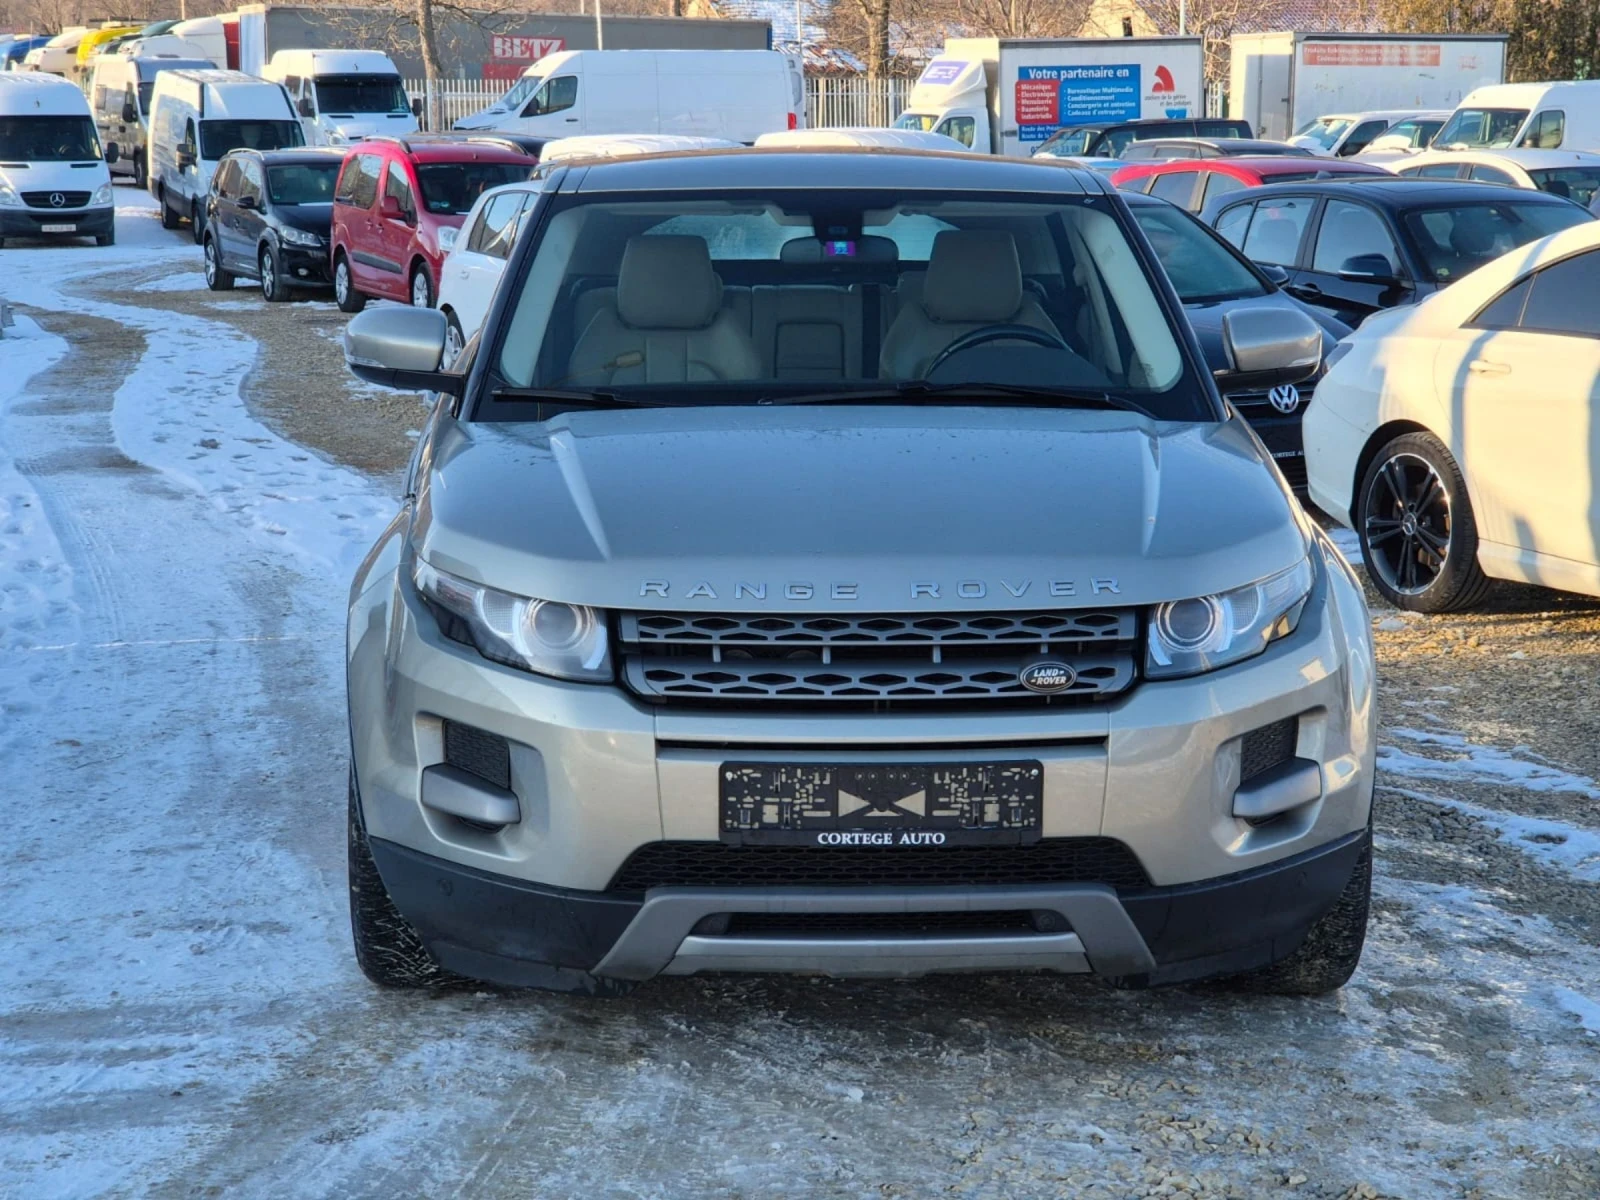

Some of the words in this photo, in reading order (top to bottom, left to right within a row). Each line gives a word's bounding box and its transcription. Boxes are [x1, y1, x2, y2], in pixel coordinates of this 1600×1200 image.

[493, 36, 562, 58] BETZ
[1028, 68, 1058, 79] Votre
[1060, 66, 1114, 81] partenaire
[1116, 69, 1129, 77] en
[639, 579, 858, 600] RANGE
[910, 577, 1121, 599] ROVER
[817, 832, 893, 845] CORTEGE
[899, 832, 946, 845] AUTO
